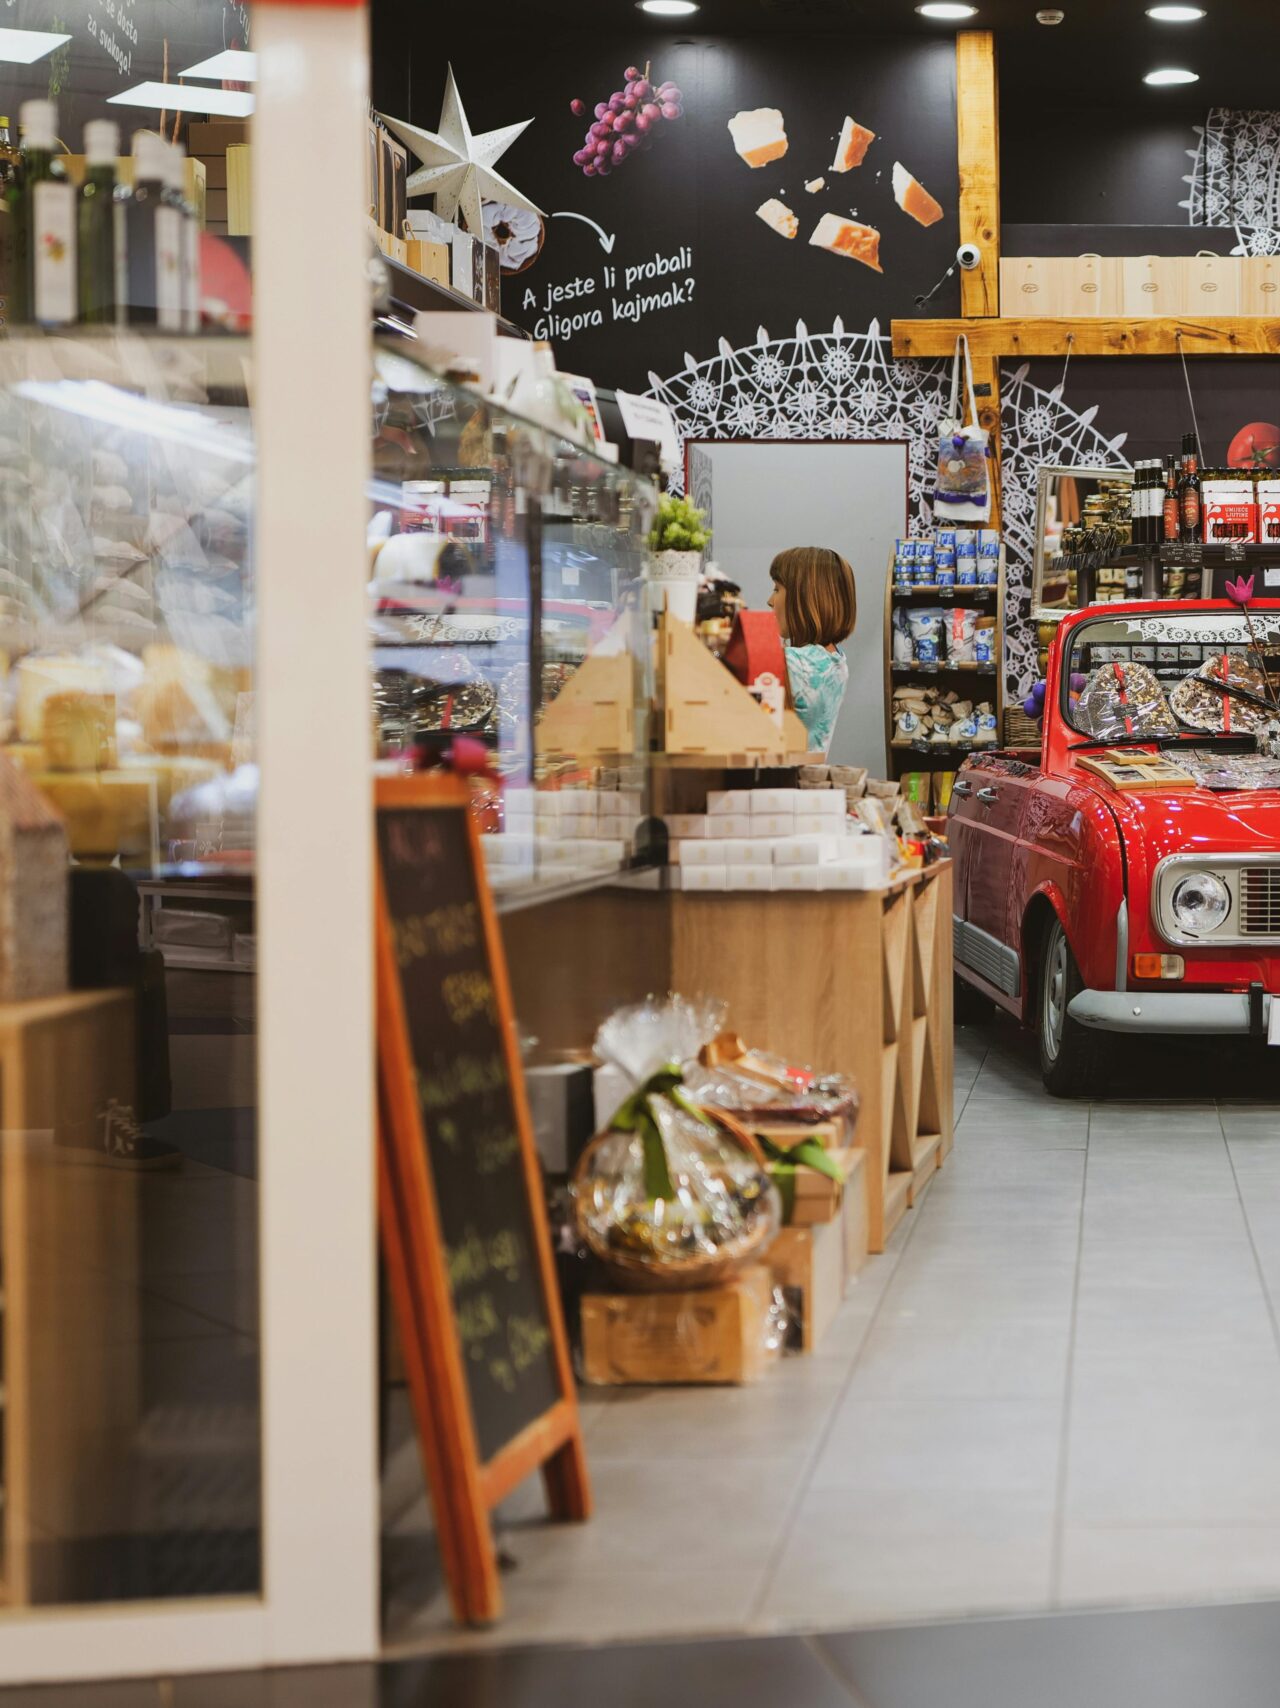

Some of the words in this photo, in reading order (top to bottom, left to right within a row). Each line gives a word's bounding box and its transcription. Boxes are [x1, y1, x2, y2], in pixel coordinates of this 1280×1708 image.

[87, 14, 97, 38] za
[99, 28, 132, 76] svakoga!
[117, 4, 138, 44] dosta
[522, 287, 537, 310] A
[543, 277, 596, 312] jeste
[603, 266, 616, 289] li
[625, 246, 693, 291] probali
[534, 310, 603, 341] Gligora
[612, 278, 695, 323] kajmak?
